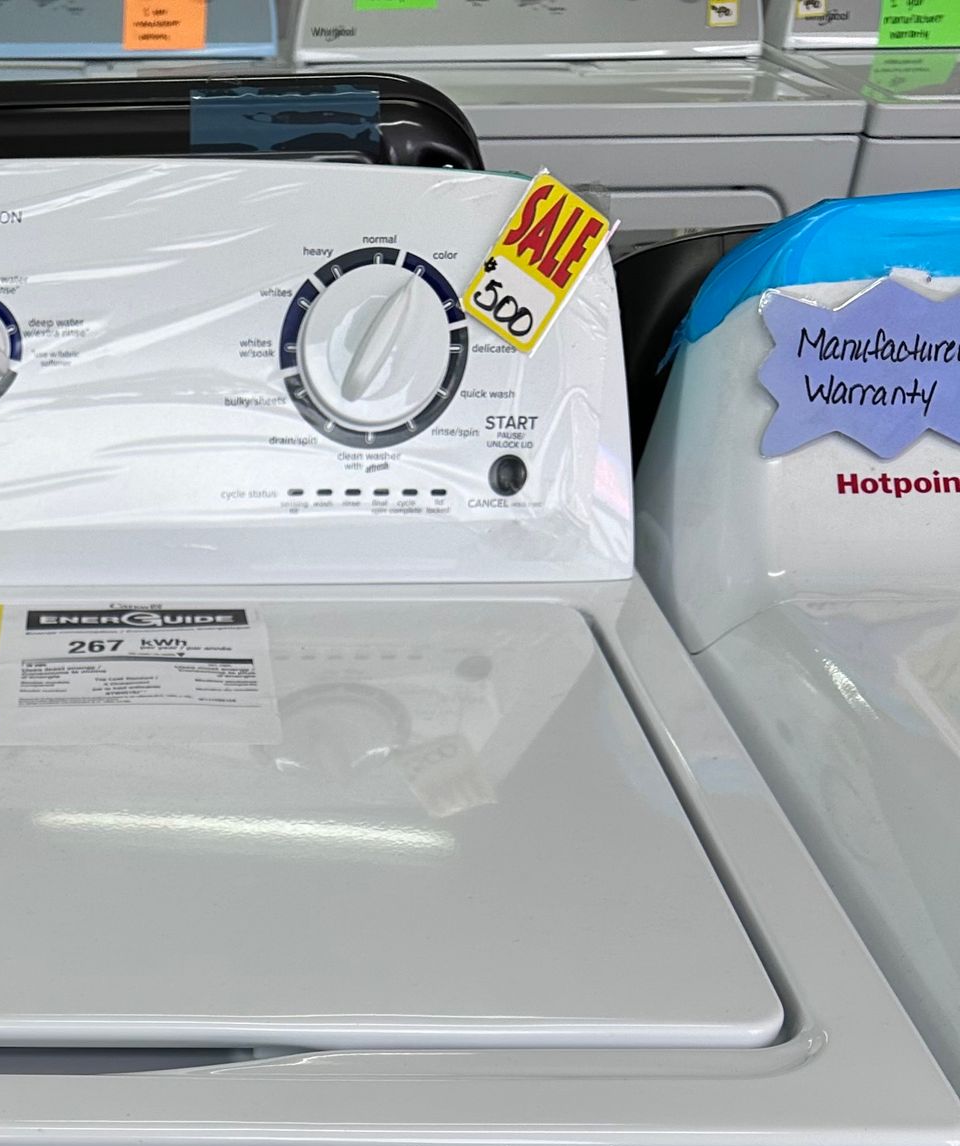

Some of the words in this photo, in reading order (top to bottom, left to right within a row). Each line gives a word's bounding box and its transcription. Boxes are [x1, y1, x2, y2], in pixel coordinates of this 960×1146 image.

[363, 235, 397, 244] normal
[502, 185, 603, 288] SALE
[303, 247, 333, 258] heavy
[433, 251, 458, 259] color
[260, 289, 293, 297] whites
[472, 344, 516, 353] delicates
[239, 350, 275, 358] w/soak
[460, 389, 487, 398] quick
[489, 390, 515, 398] wash
[805, 375, 937, 417] Warranty
[485, 416, 538, 430] START
[432, 428, 479, 438] rinse/spin
[337, 452, 363, 461] clean
[468, 500, 508, 508] CANCEL
[39, 612, 235, 626] ENERGUIDE
[68, 640, 124, 654] 267
